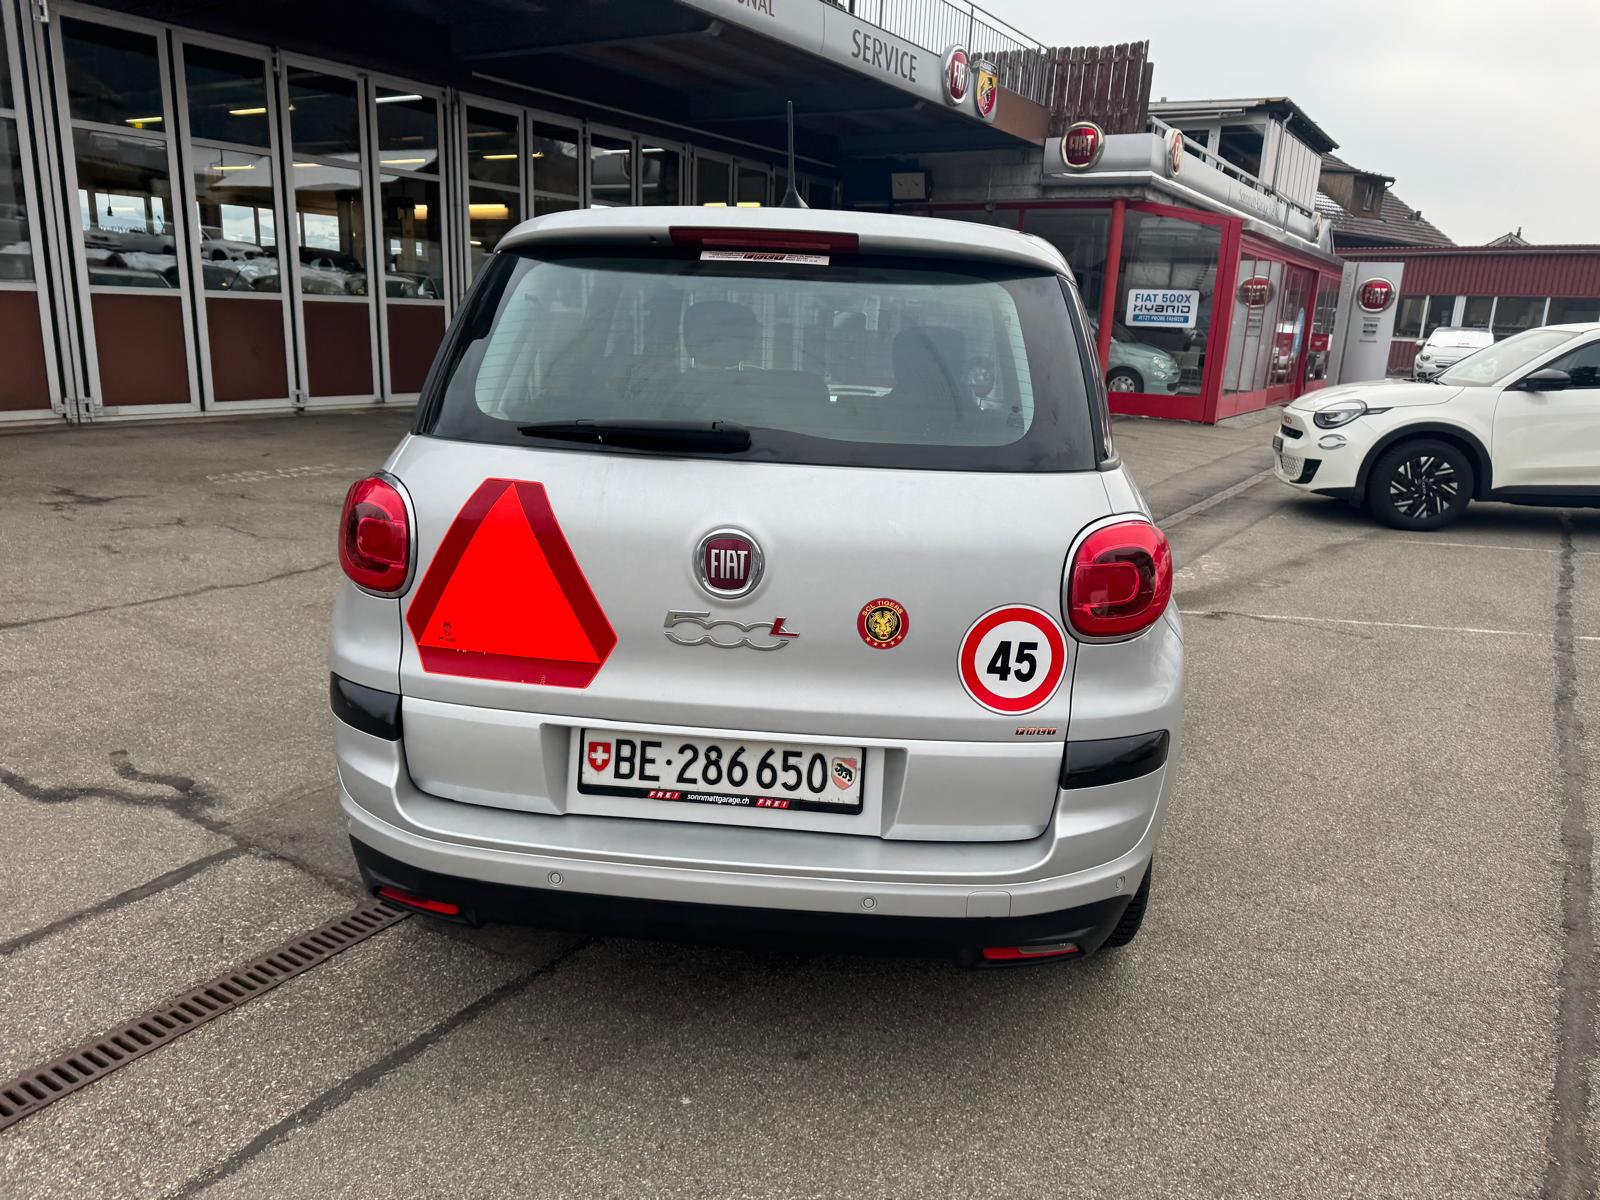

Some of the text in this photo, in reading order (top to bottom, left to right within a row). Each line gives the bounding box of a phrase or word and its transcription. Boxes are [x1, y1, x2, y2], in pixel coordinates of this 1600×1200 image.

[851, 29, 918, 83] SERVICE
[1068, 134, 1095, 157] FIAT
[1134, 293, 1192, 304] FIAT 500X
[1364, 287, 1388, 305] FIAT
[1133, 304, 1191, 314] HYBRID
[710, 549, 748, 580] FIAT
[862, 600, 904, 616] SCL TIGERS
[986, 640, 1039, 683] 45
[648, 791, 787, 809] FREI sonnmattgarage.ch FREI
